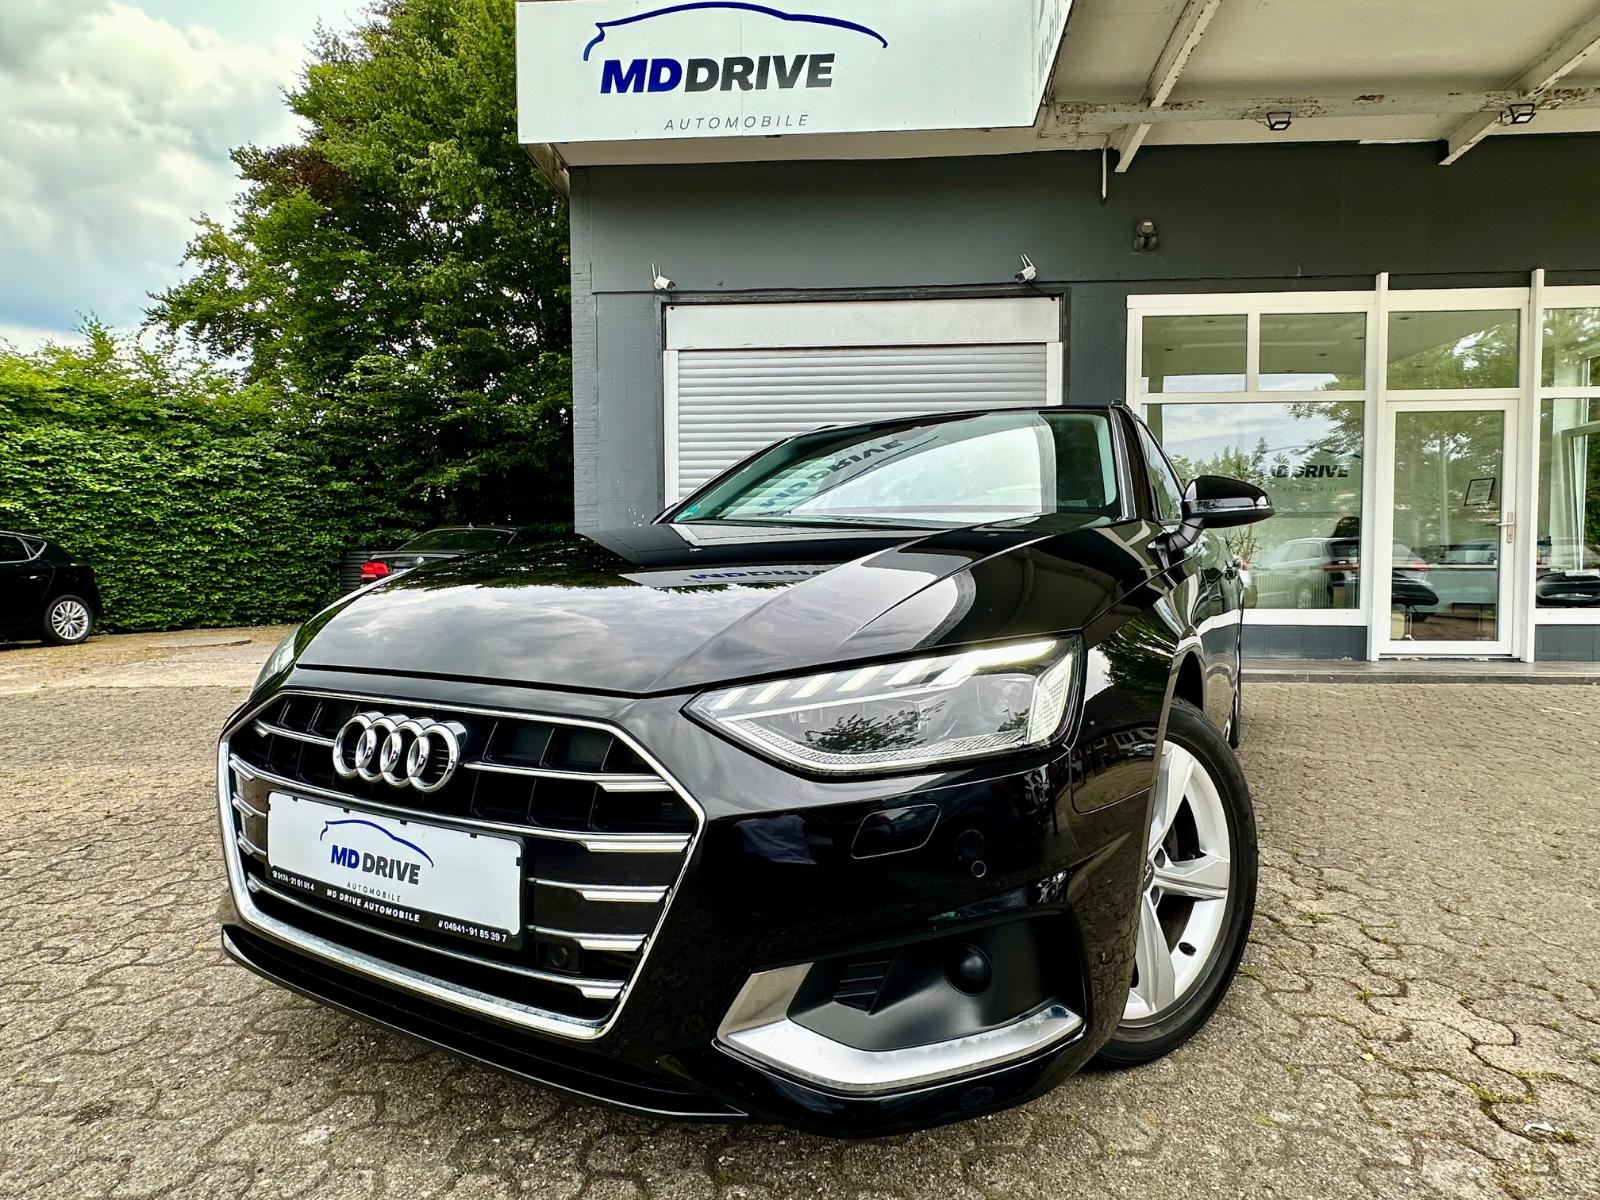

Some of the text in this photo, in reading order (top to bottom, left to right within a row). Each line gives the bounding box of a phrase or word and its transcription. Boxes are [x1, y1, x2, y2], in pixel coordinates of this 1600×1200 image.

[664, 114, 809, 131] AUTOMOBILE
[331, 845, 421, 885] MD DRIVE
[326, 889, 420, 922] MD DRIVE AUTOMOBILE
[346, 881, 401, 903] AUTOMOBILE
